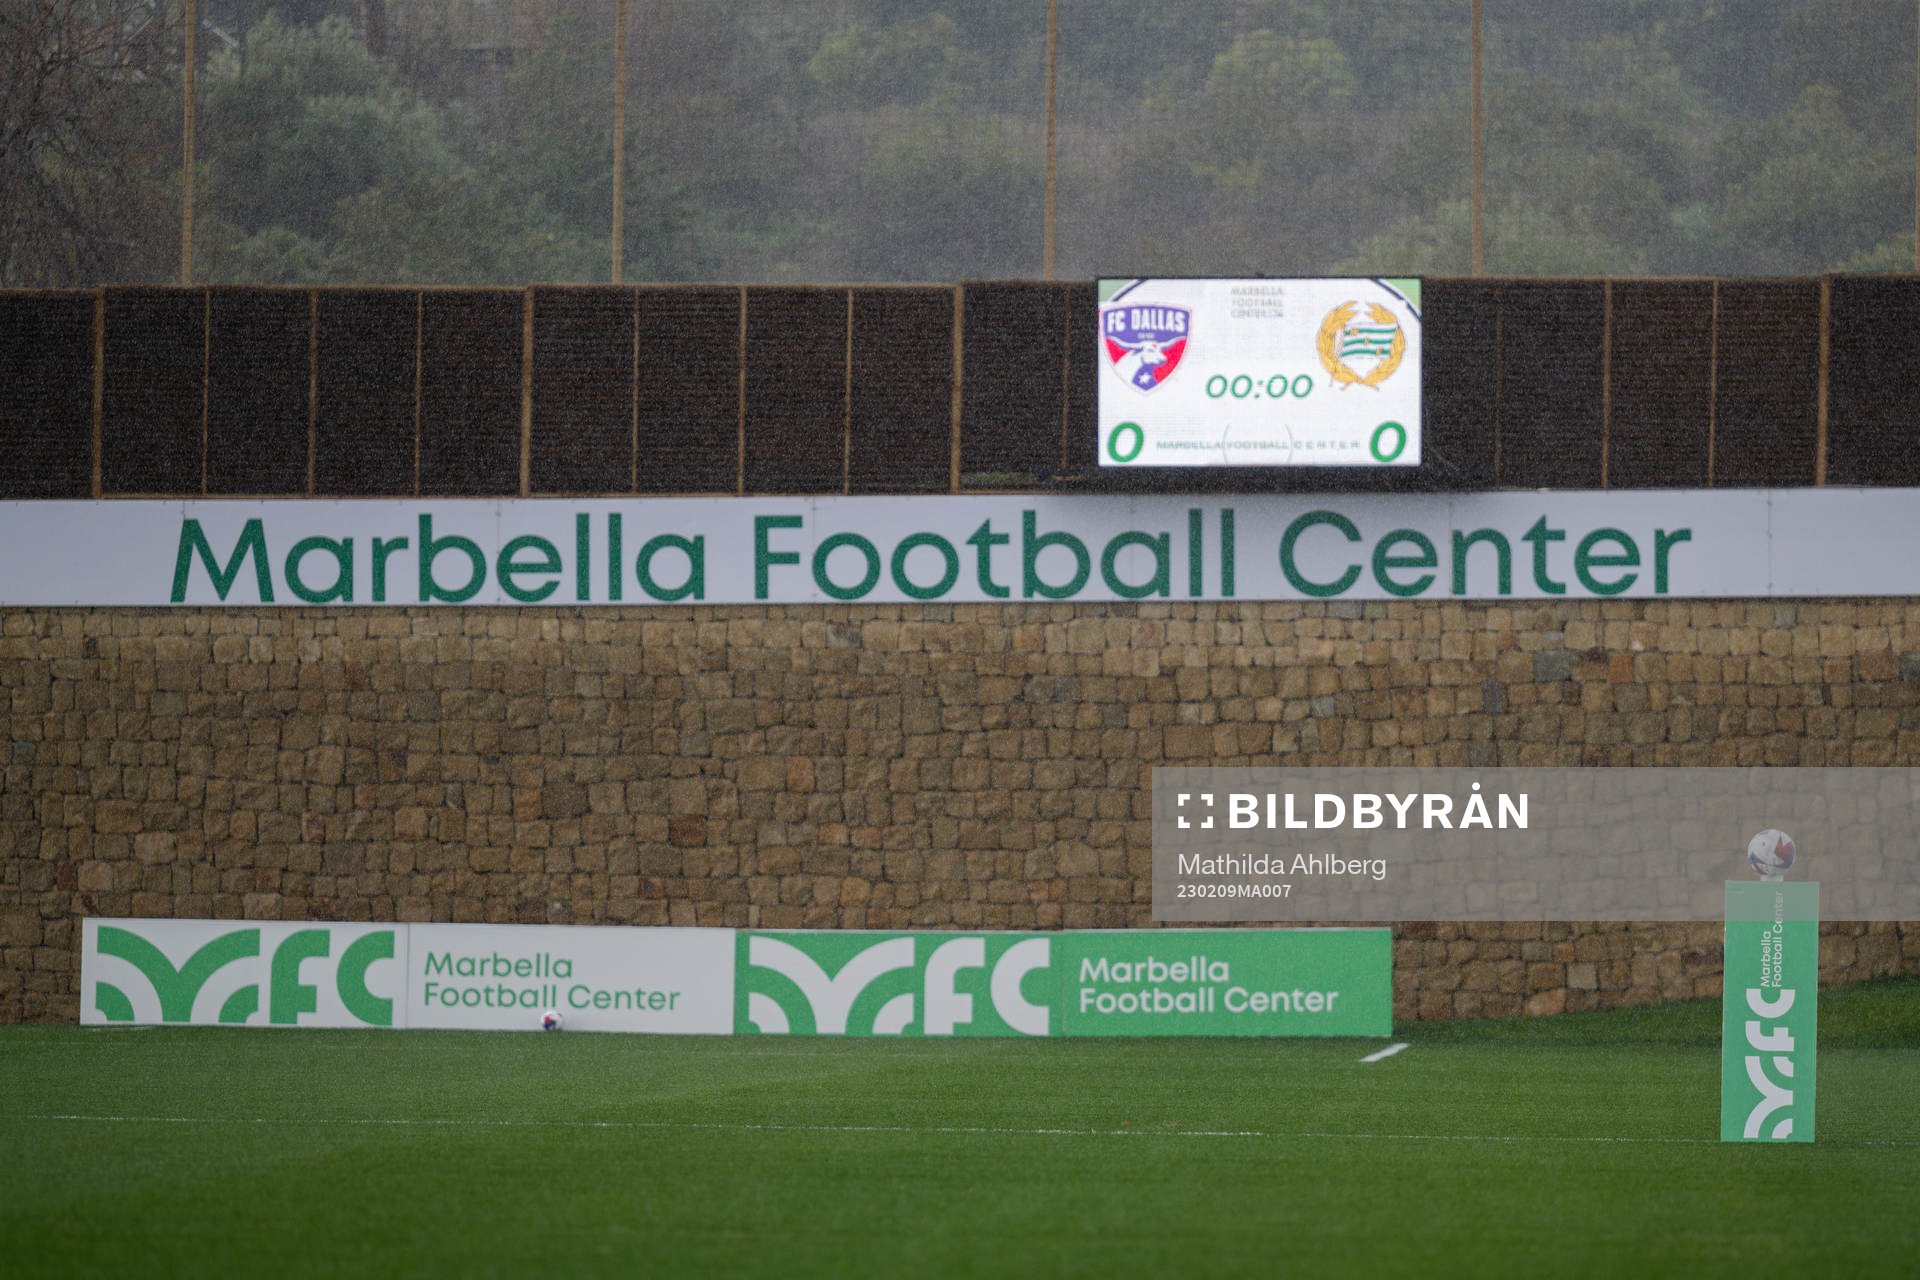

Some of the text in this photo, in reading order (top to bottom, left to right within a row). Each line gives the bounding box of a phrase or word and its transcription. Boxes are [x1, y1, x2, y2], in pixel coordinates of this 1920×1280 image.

[1107, 308, 1185, 333] FC DALLAS
[1205, 374, 1313, 399] 00:00
[1107, 421, 1145, 463] 0
[1369, 421, 1407, 463] 0
[170, 508, 1693, 604] Marbella Football Center
[1771, 890, 1783, 988] Football Center
[424, 951, 574, 979] Marbella
[1079, 956, 1230, 984] Marbella
[1760, 931, 1771, 988] Marbella
[424, 981, 682, 1012] Football Center
[1079, 987, 1340, 1014] Football Center
